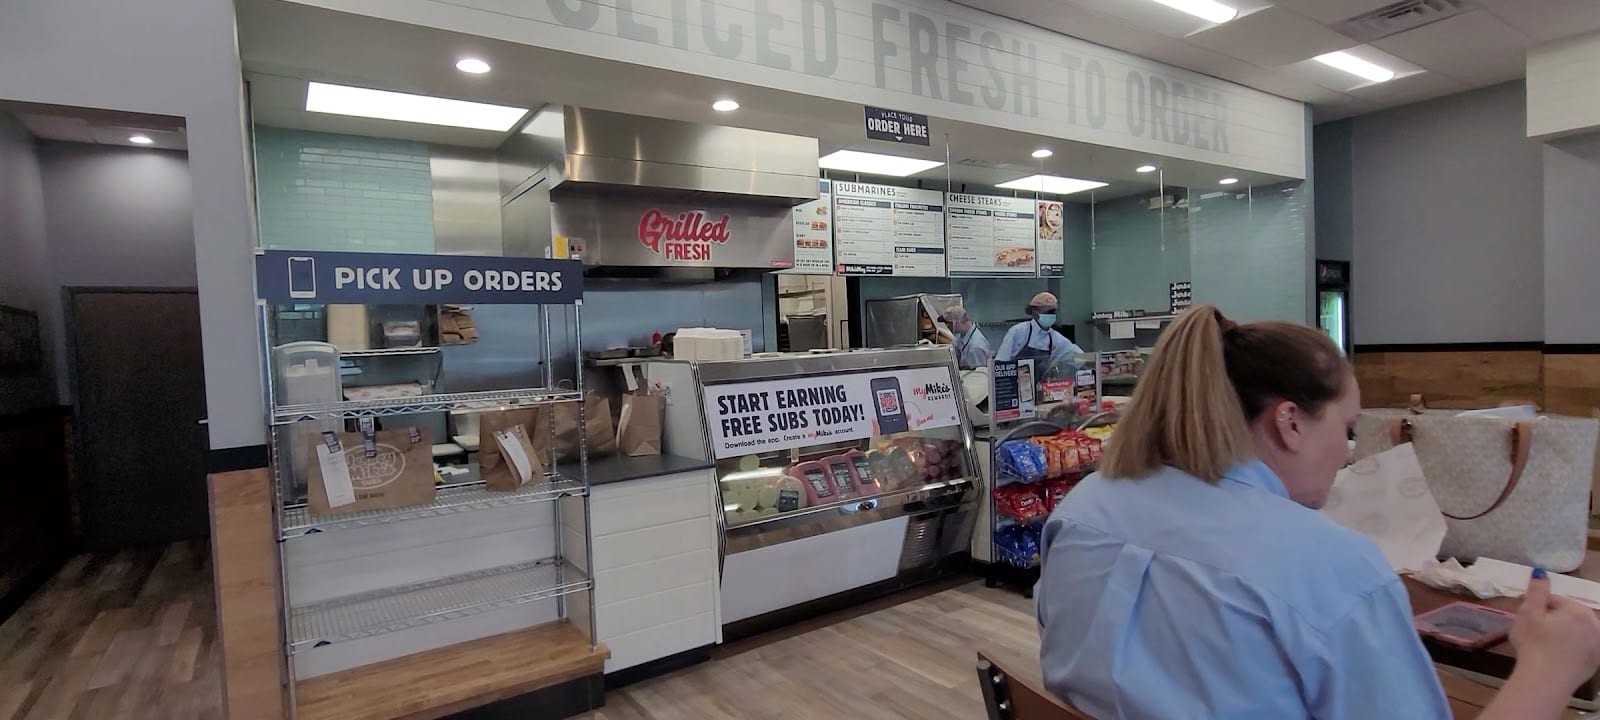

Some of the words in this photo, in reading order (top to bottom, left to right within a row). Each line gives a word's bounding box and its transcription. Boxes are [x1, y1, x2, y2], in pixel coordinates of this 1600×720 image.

[549, 0, 839, 78] ICED
[872, 3, 1040, 118] FRESH
[1060, 51, 1107, 129] TO
[1126, 69, 1231, 154] ORDER
[867, 117, 901, 134] ORDER
[903, 122, 928, 138] HERE
[899, 113, 913, 122] YOUR
[839, 182, 896, 197] SUBMARINES
[949, 194, 975, 204] CHEESE
[977, 197, 1002, 206] STEAKS
[639, 208, 731, 253] Grilled
[665, 243, 711, 261] FRESH
[335, 267, 401, 290] PICK
[412, 268, 453, 290] UP
[463, 270, 563, 292] ORDERS
[717, 391, 770, 416] START
[775, 384, 848, 410] EARNING
[721, 415, 764, 438] FREE
[769, 409, 809, 433] SUBS
[812, 403, 866, 427] TODAY!
[724, 439, 756, 449] Download
[757, 438, 766, 446] the
[783, 433, 801, 442] Create
